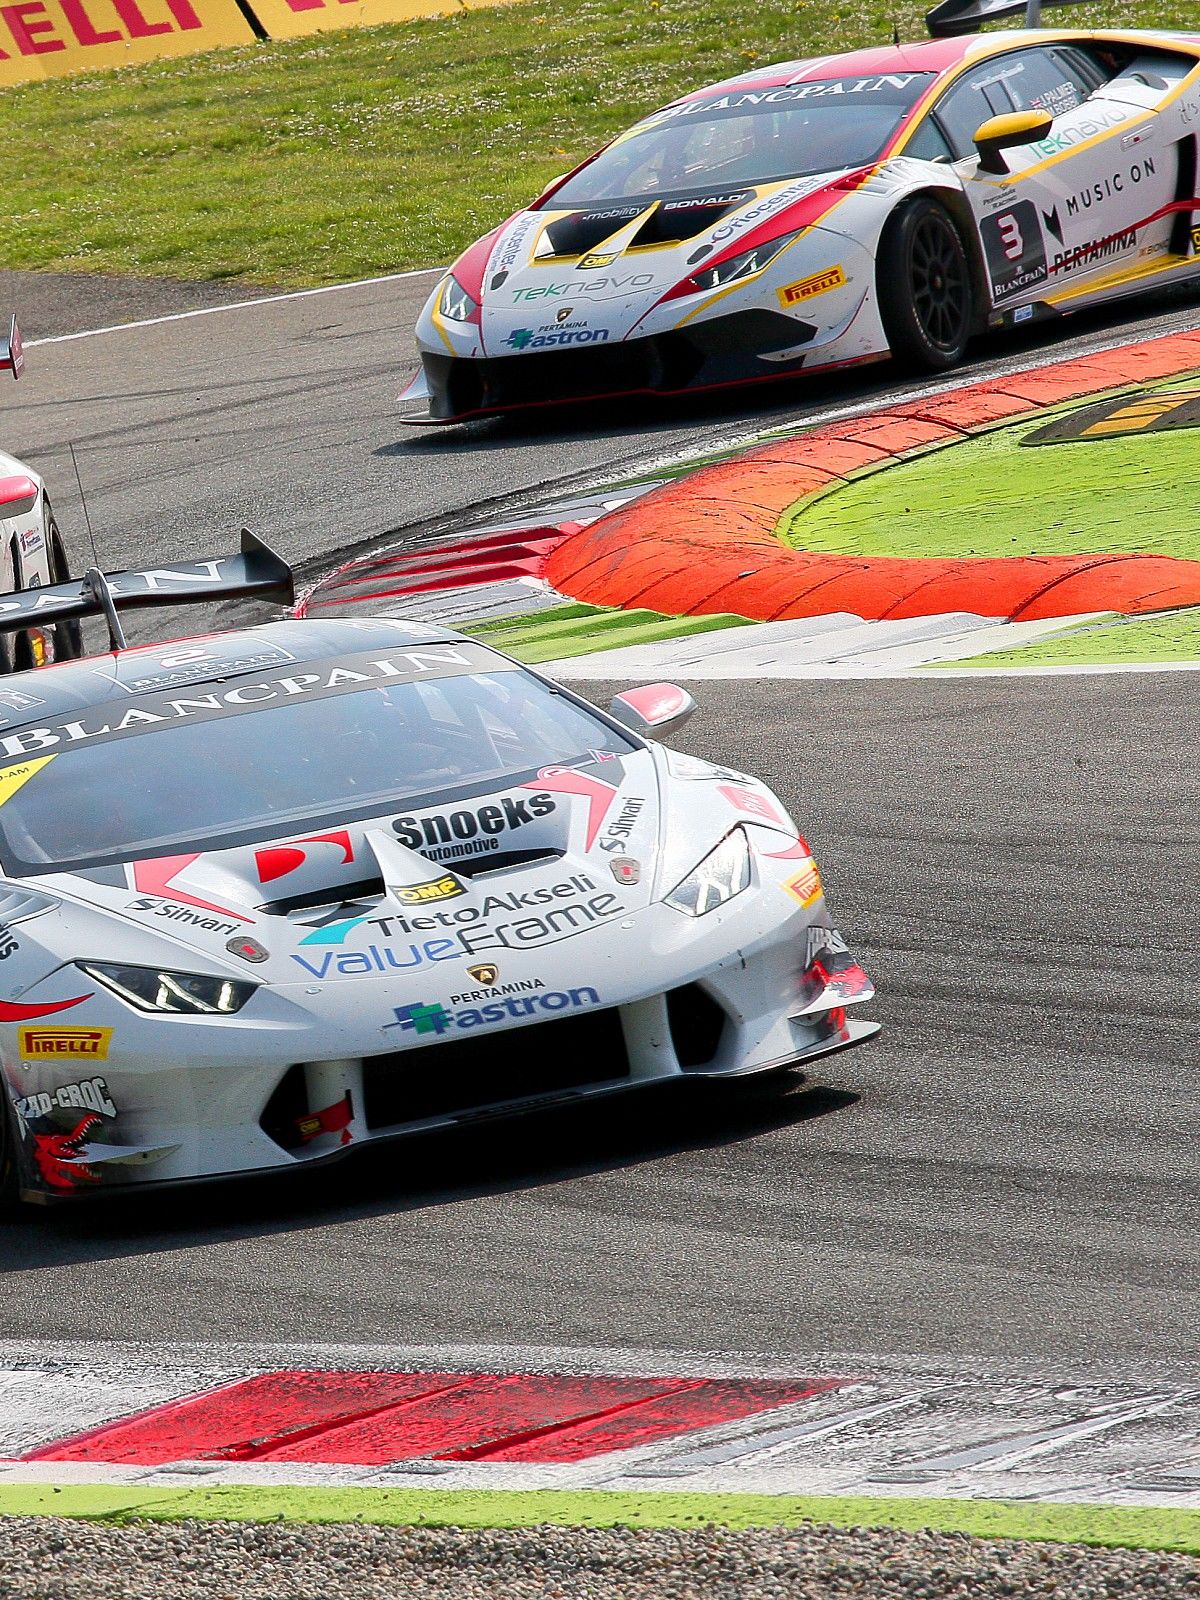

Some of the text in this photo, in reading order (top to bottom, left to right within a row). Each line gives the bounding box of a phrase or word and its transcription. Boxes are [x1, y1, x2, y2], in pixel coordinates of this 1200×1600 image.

[648, 73, 922, 122] BLANCPAIN
[664, 193, 747, 210] BONALDI
[1066, 157, 1155, 216] MUSIC ON
[997, 213, 1023, 260] 3
[1054, 229, 1137, 276] PERTAMINA
[784, 269, 841, 302] PIRELLI
[994, 264, 1047, 297] BLANCPAIN
[538, 320, 588, 333] PERTAMINA
[132, 652, 280, 688] BLANCPAIN
[391, 793, 556, 850] Snoeks
[609, 797, 646, 838] Sihvari
[420, 836, 499, 862] Automotive
[367, 873, 597, 937] TietoAkseli
[398, 879, 458, 902] OMP
[154, 904, 242, 936] Sihvari
[289, 892, 625, 979] ValueFrame
[450, 977, 546, 1006] PERTAMINA
[24, 1031, 103, 1054] PIRELLI
